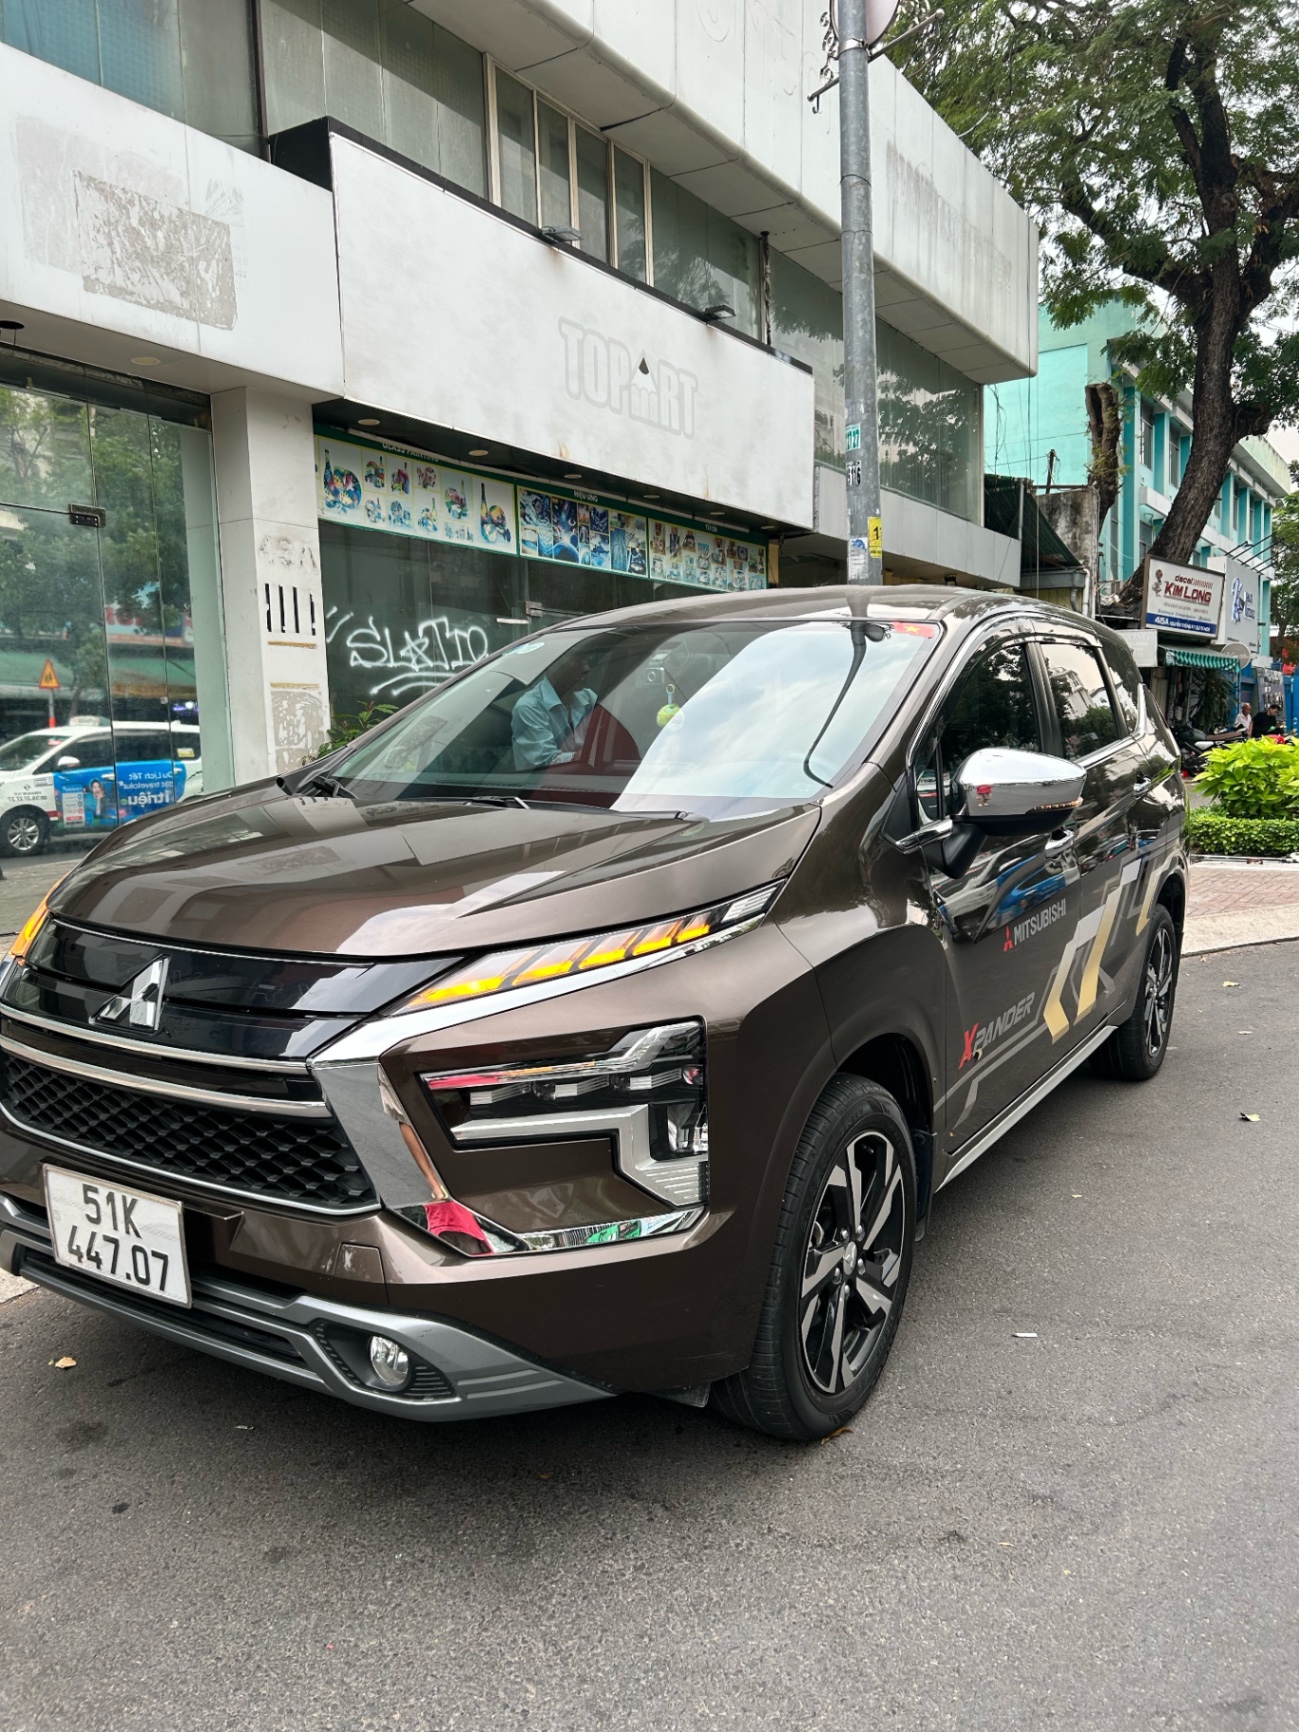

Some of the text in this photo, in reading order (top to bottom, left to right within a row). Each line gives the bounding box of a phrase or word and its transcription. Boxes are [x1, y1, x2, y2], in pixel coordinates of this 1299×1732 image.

[1164, 580, 1212, 604] KIM LONG
[1013, 898, 1067, 946] MITSUBISHI
[958, 992, 1035, 1070] XPANDER
[82, 1183, 142, 1239] 51K
[67, 1225, 169, 1292] 447.07
